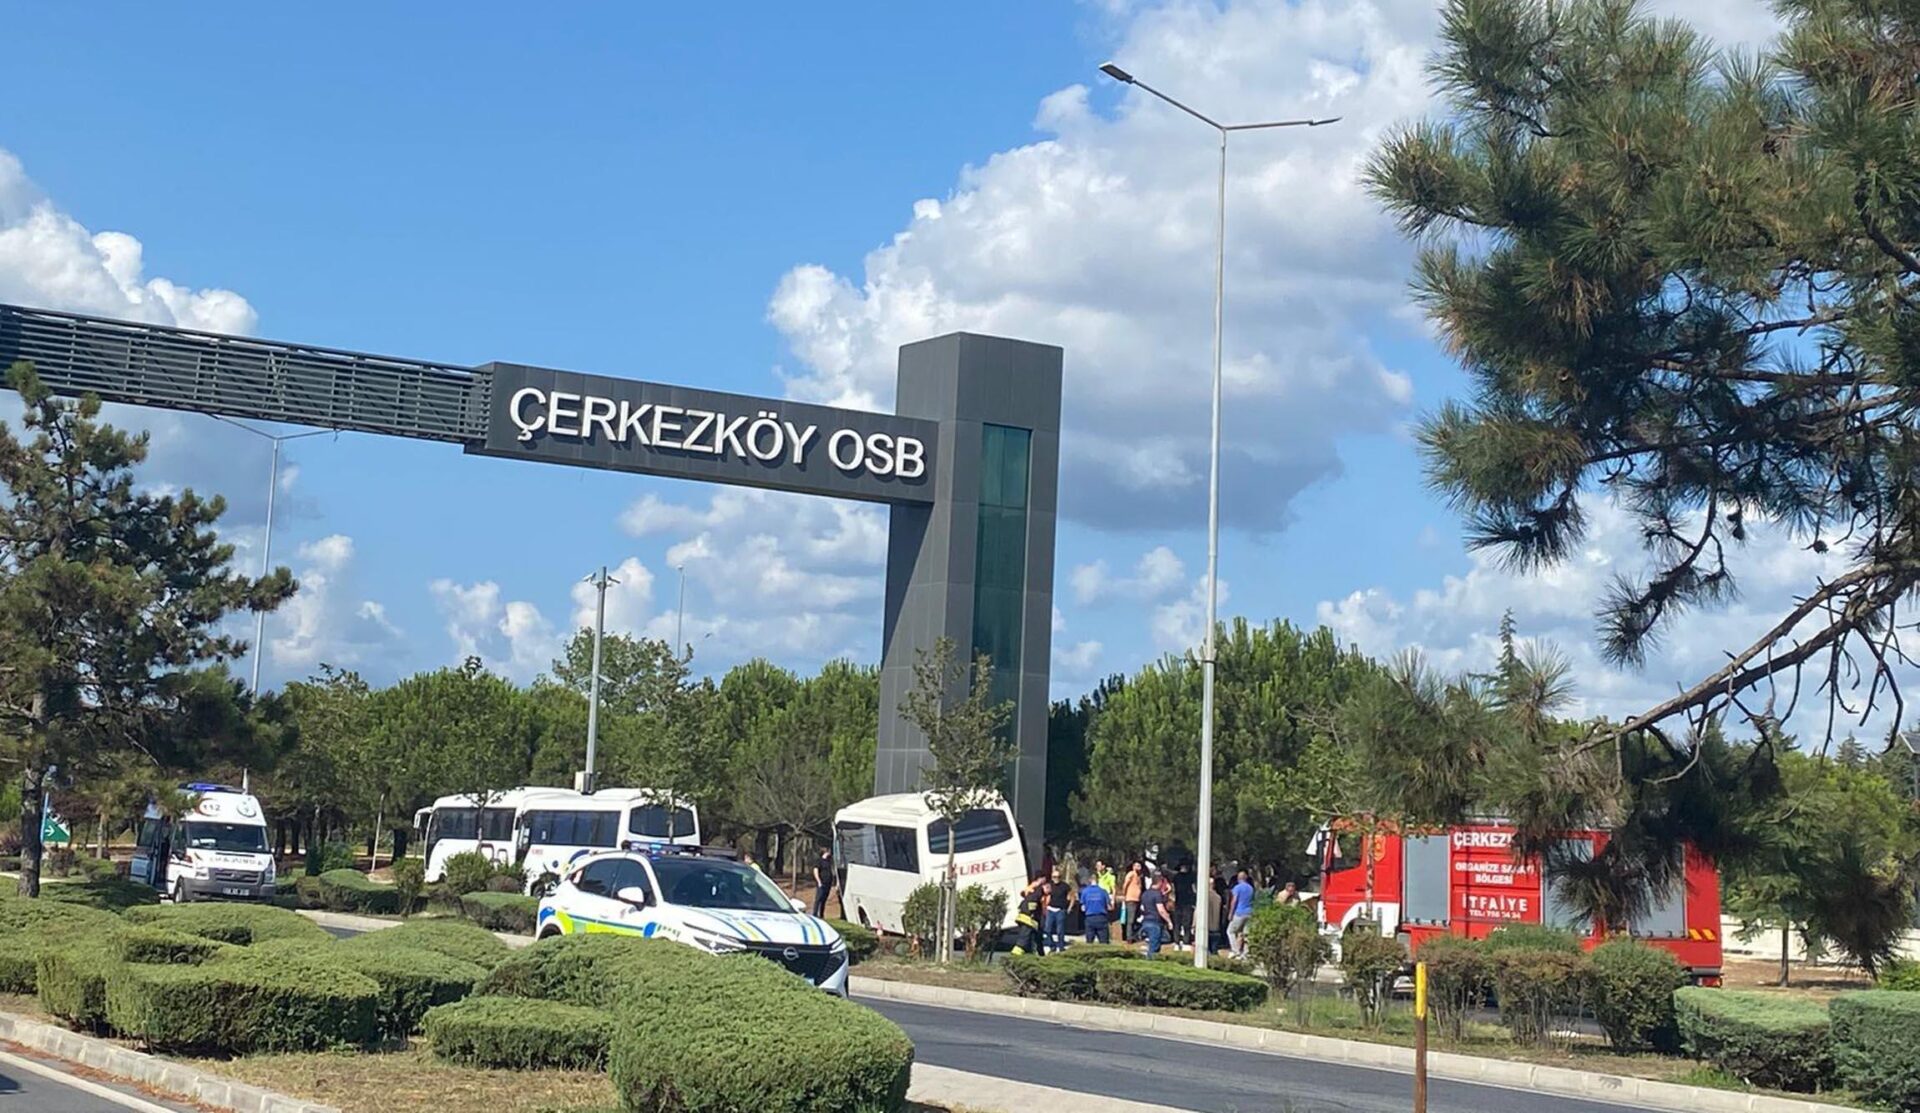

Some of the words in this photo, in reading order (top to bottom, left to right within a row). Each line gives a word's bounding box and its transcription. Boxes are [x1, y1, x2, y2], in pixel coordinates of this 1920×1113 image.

[509, 388, 817, 464] ÇERKEZKÖY
[828, 428, 926, 478] OSB
[203, 803, 221, 812] 112
[1462, 893, 1528, 912] İTFAİYE
